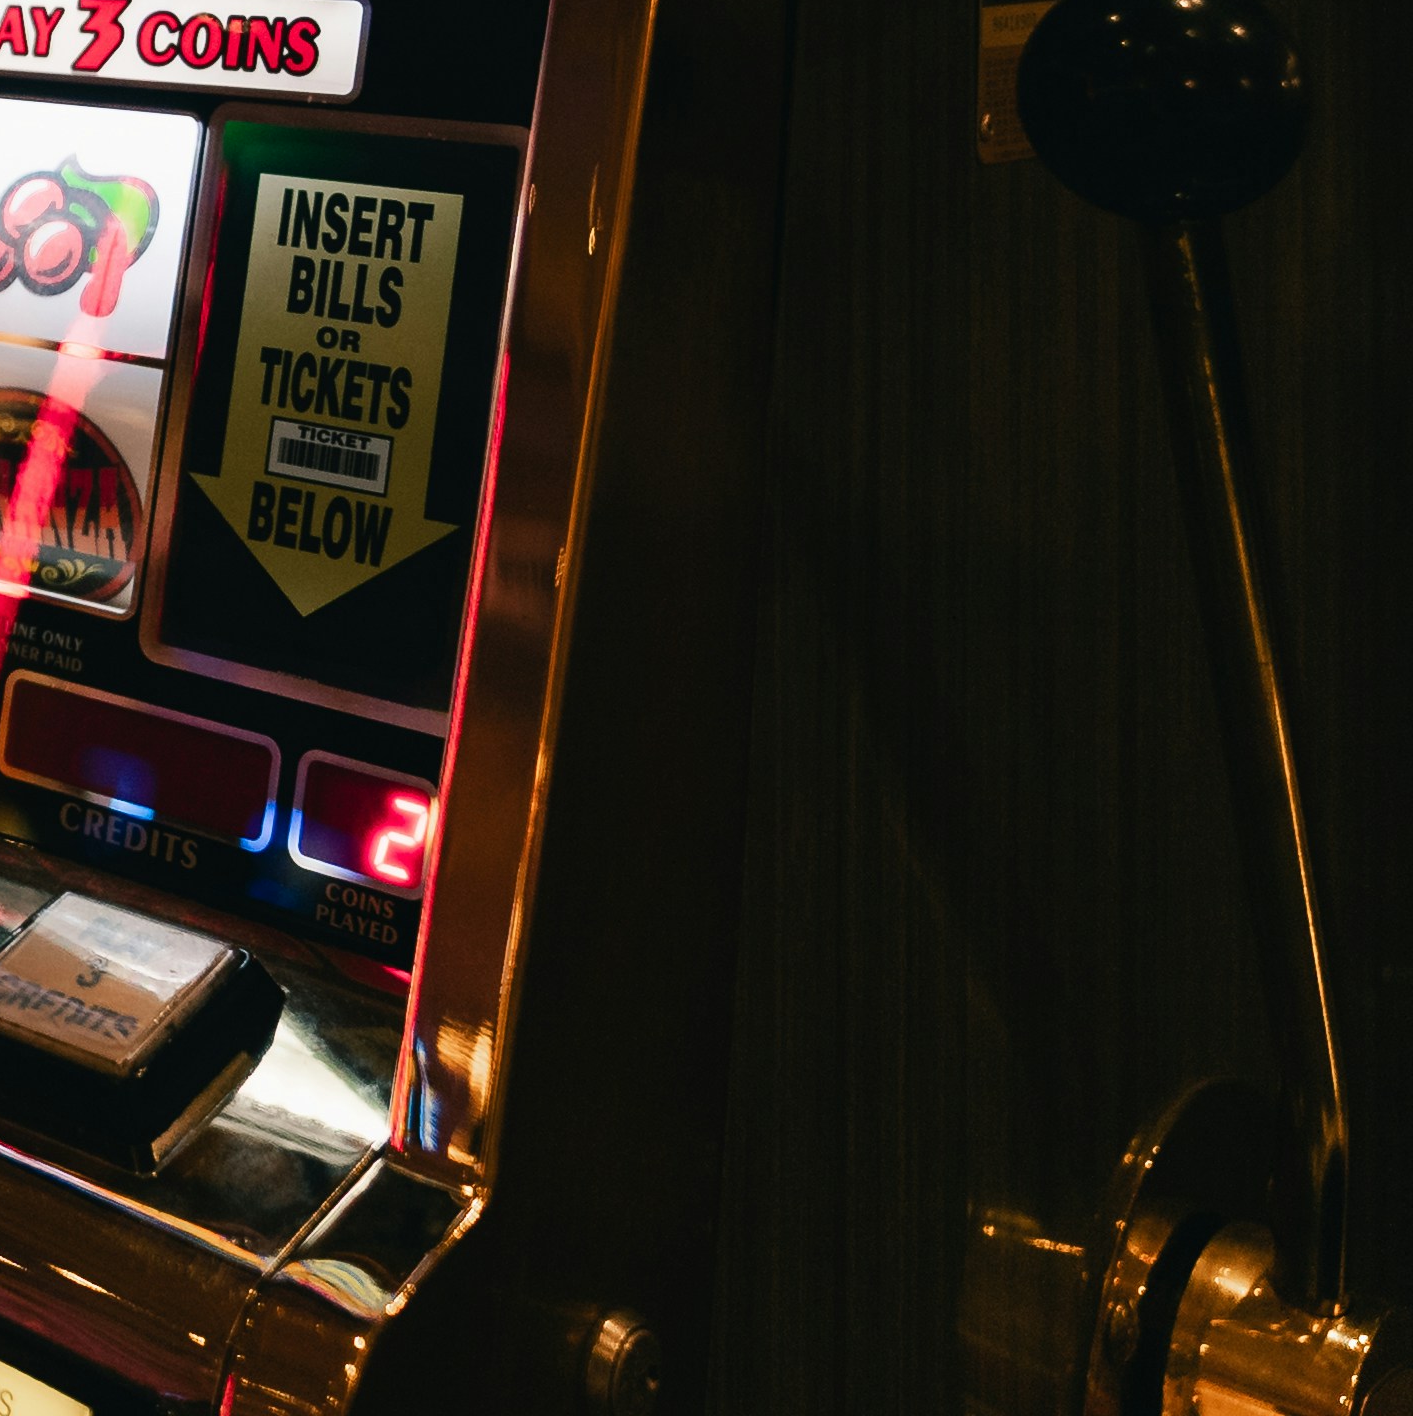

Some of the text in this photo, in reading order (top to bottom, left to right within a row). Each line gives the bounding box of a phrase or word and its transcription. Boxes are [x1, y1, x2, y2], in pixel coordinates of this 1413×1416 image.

[137, 11, 322, 77] COINS
[277, 188, 434, 263] INSERT
[287, 255, 404, 328] BILLS
[316, 326, 360, 352] OR
[260, 346, 412, 429] TICKETS
[297, 425, 372, 451] TICKET
[247, 481, 393, 568] BELOW
[5, 621, 38, 640] LINE
[42, 630, 83, 652] ONLY
[44, 651, 83, 672] PAID
[60, 802, 199, 869] CREDITS
[373, 797, 429, 881] 2
[315, 903, 399, 945] PLAYED
[325, 882, 395, 920] COINS
